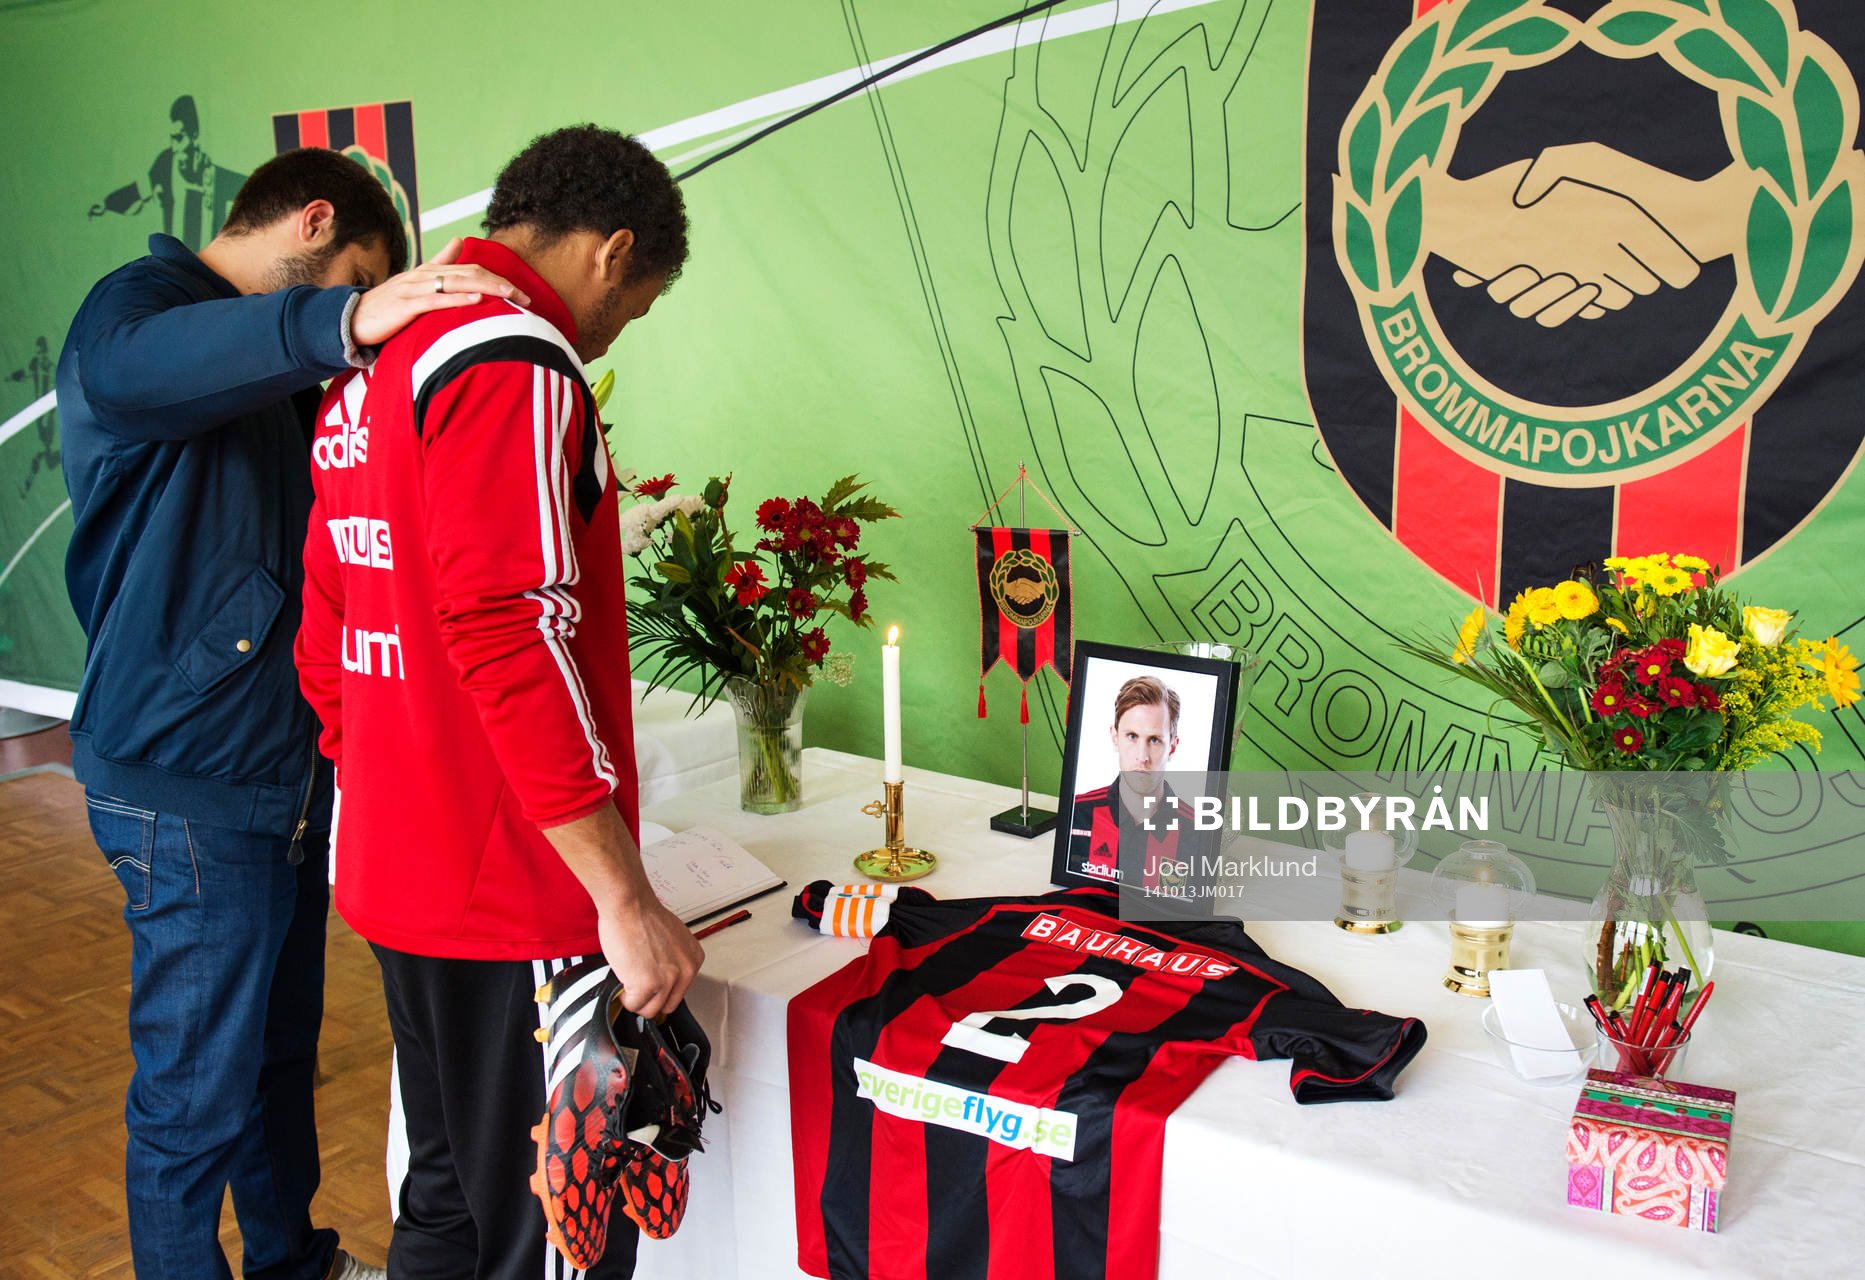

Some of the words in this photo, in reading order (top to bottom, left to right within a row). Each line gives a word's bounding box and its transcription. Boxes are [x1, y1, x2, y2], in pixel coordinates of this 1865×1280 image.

[1381, 304, 1774, 467] BROMMAPOJKARNA
[1028, 917, 1231, 977] BAUHAUS
[940, 973, 1124, 1065] 2
[857, 1071, 1072, 1147] sverigeflyg.se
